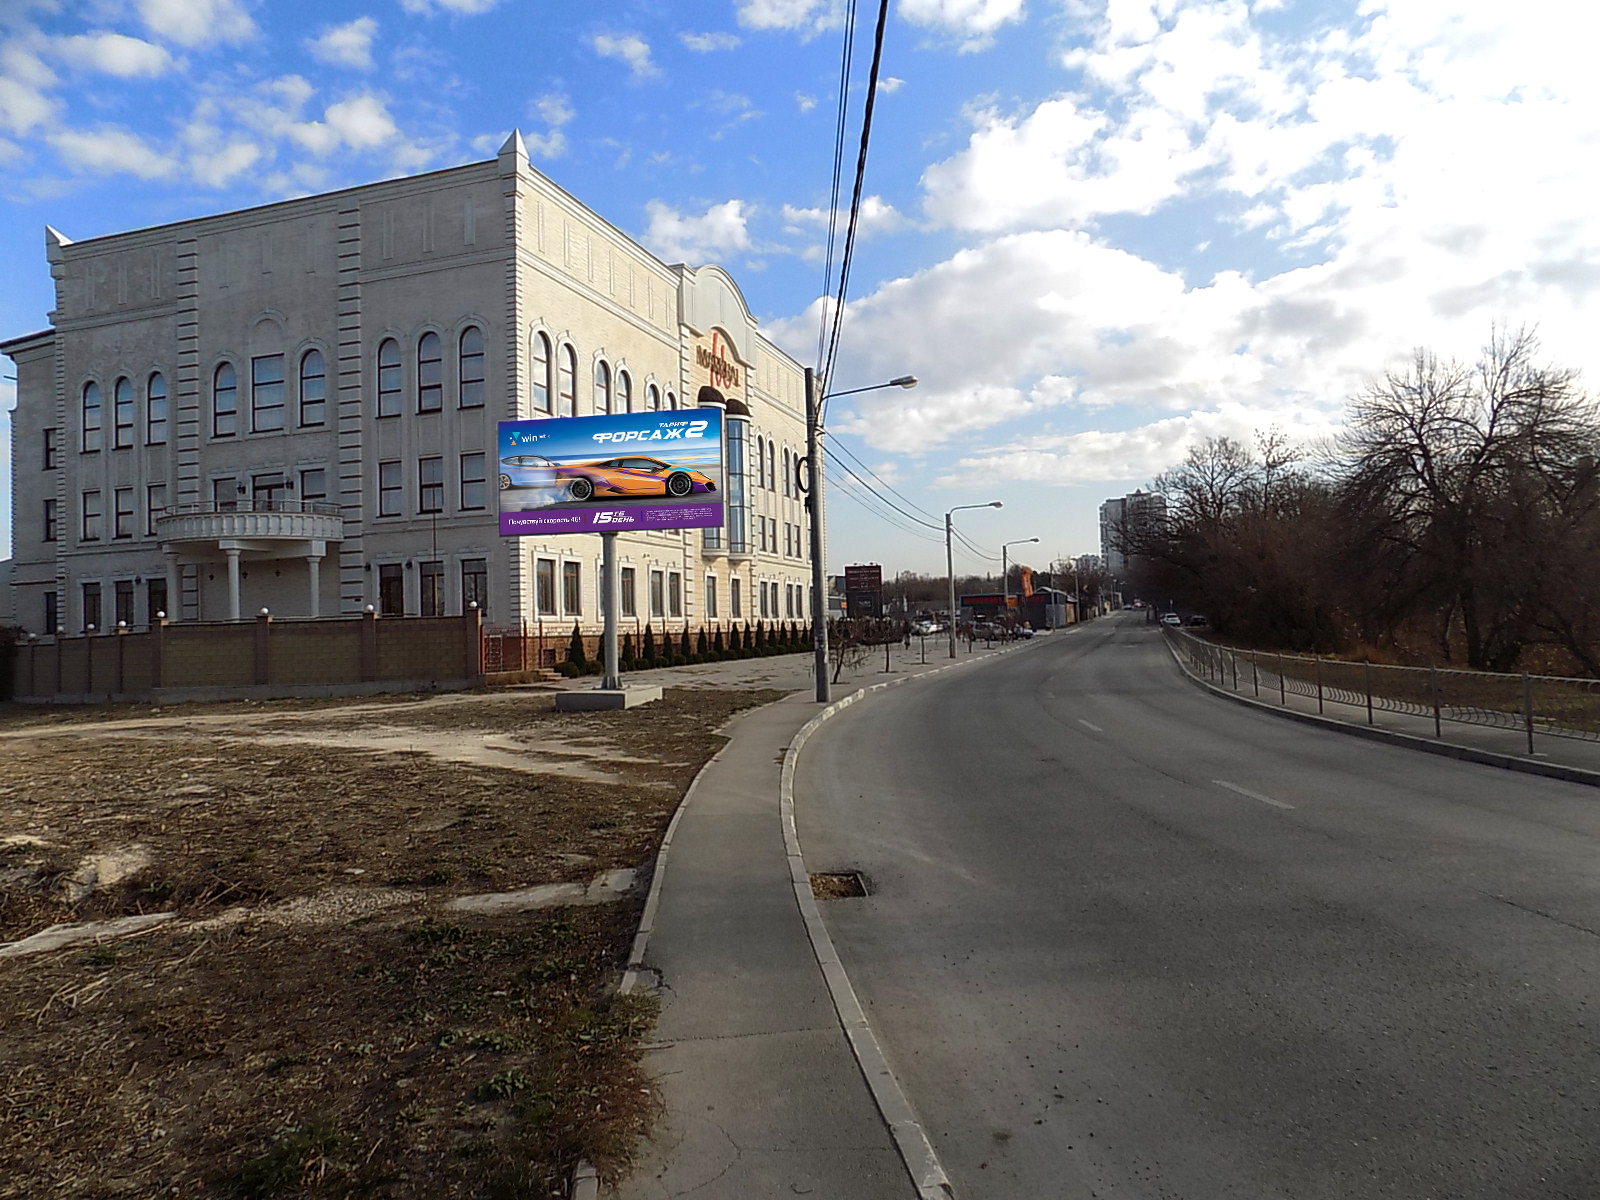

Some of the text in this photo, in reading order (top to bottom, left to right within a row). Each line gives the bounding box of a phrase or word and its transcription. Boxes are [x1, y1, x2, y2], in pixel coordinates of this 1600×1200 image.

[521, 433, 538, 443] win
[592, 420, 709, 444] ФОРСАЖ 2
[592, 511, 613, 524] 15
